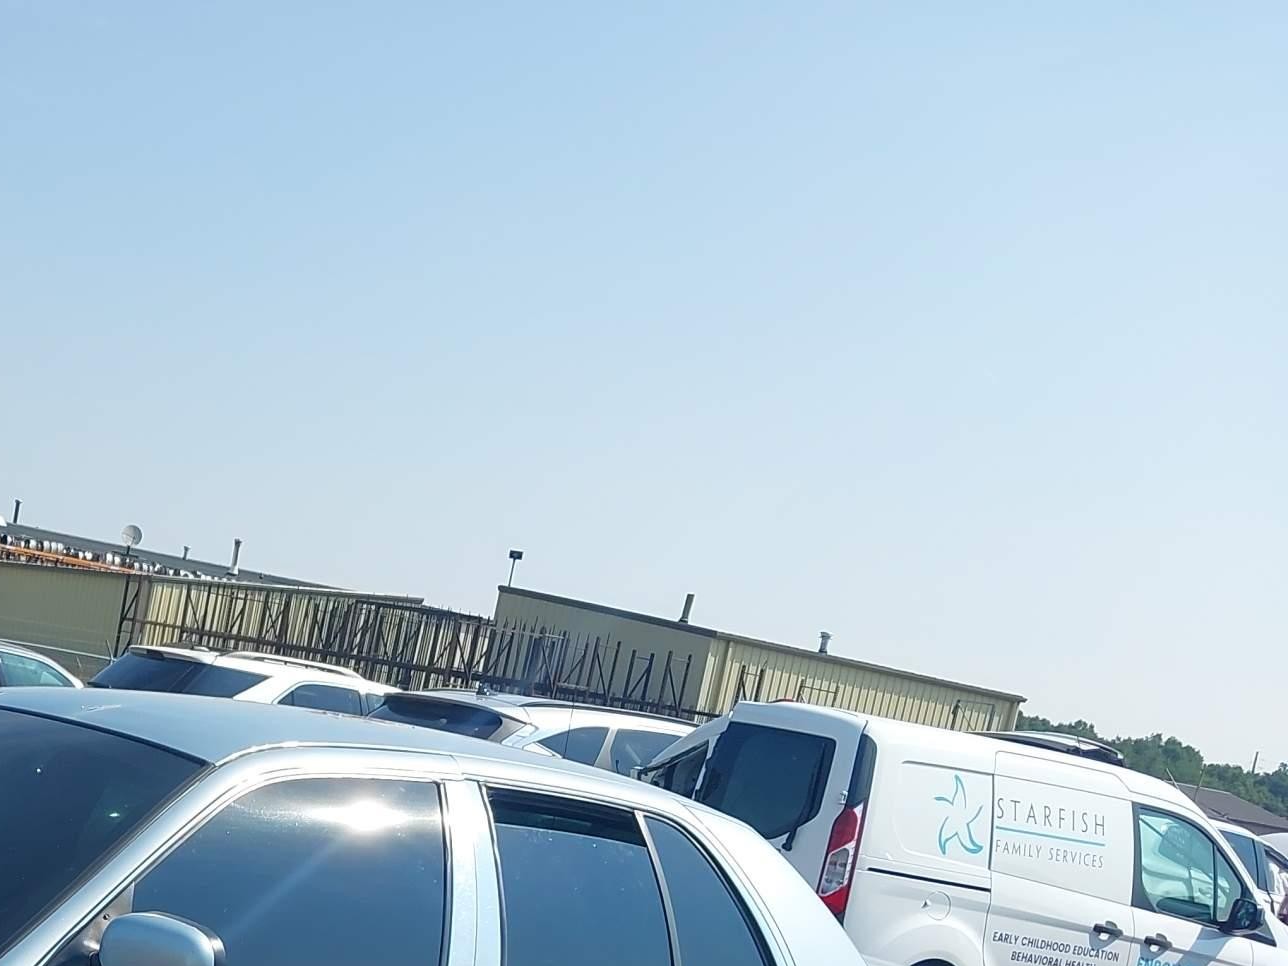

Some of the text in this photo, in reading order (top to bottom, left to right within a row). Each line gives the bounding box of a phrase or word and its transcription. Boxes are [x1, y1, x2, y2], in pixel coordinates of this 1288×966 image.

[996, 797, 1105, 836] STARFISH
[995, 839, 1104, 868] FAMILY SERVICES
[992, 931, 1120, 962] EARLY CHILDHOOD EDUCATION
